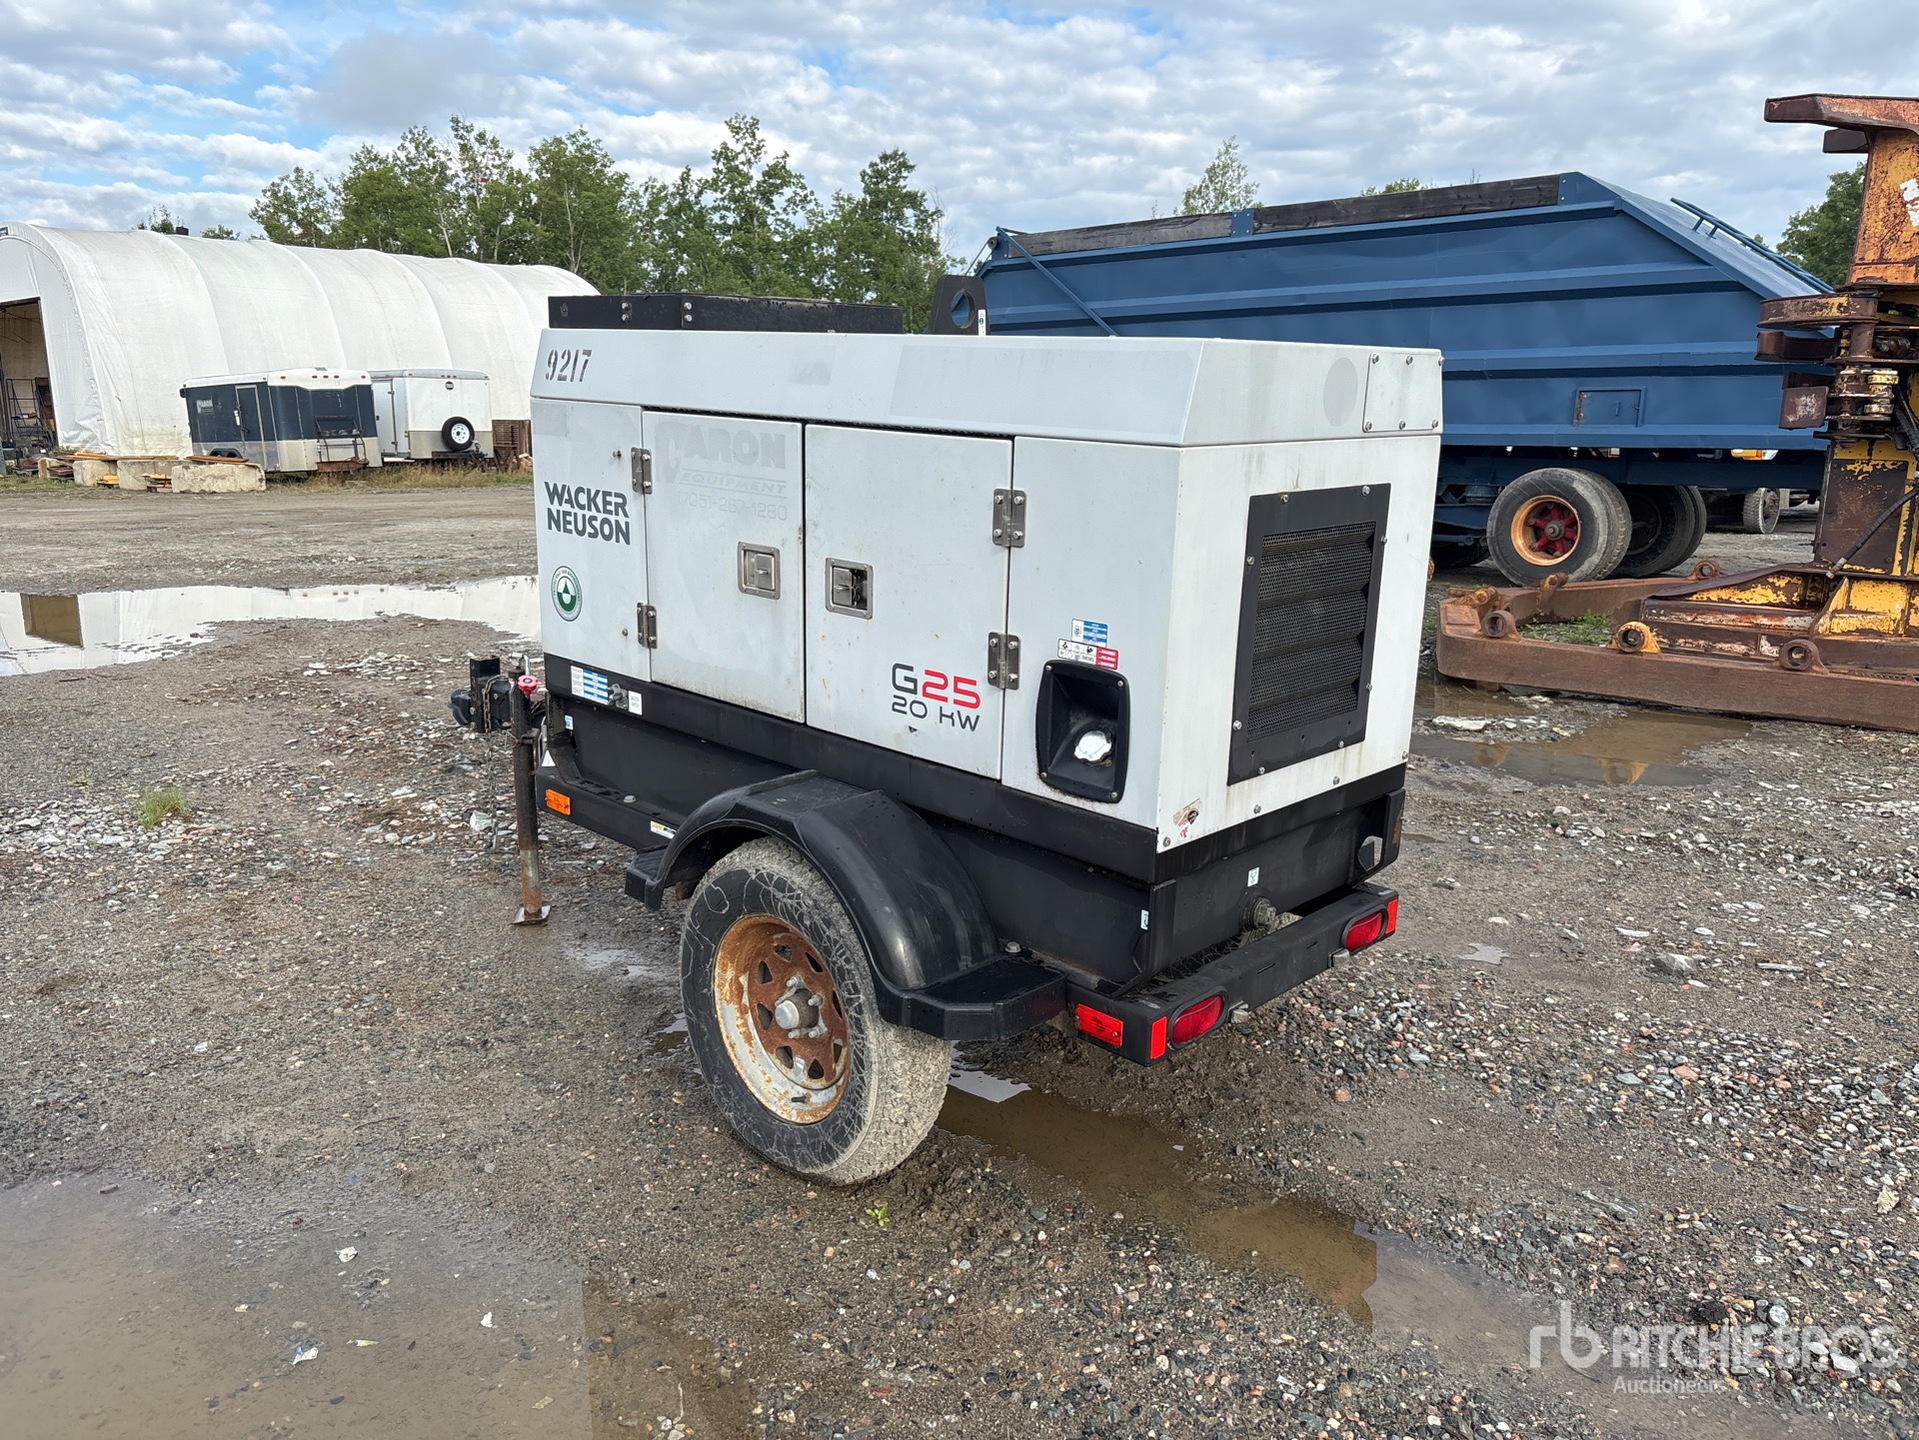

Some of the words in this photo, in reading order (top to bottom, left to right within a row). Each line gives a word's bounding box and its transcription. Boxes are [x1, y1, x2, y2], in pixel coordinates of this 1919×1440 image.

[545, 349, 592, 382] 9217
[655, 421, 786, 483] CARON
[544, 481, 630, 518] WACKER
[681, 472, 787, 494] EQUIPMENT
[547, 507, 630, 546] NEUSON
[892, 663, 981, 710] G25
[892, 694, 928, 719] 20
